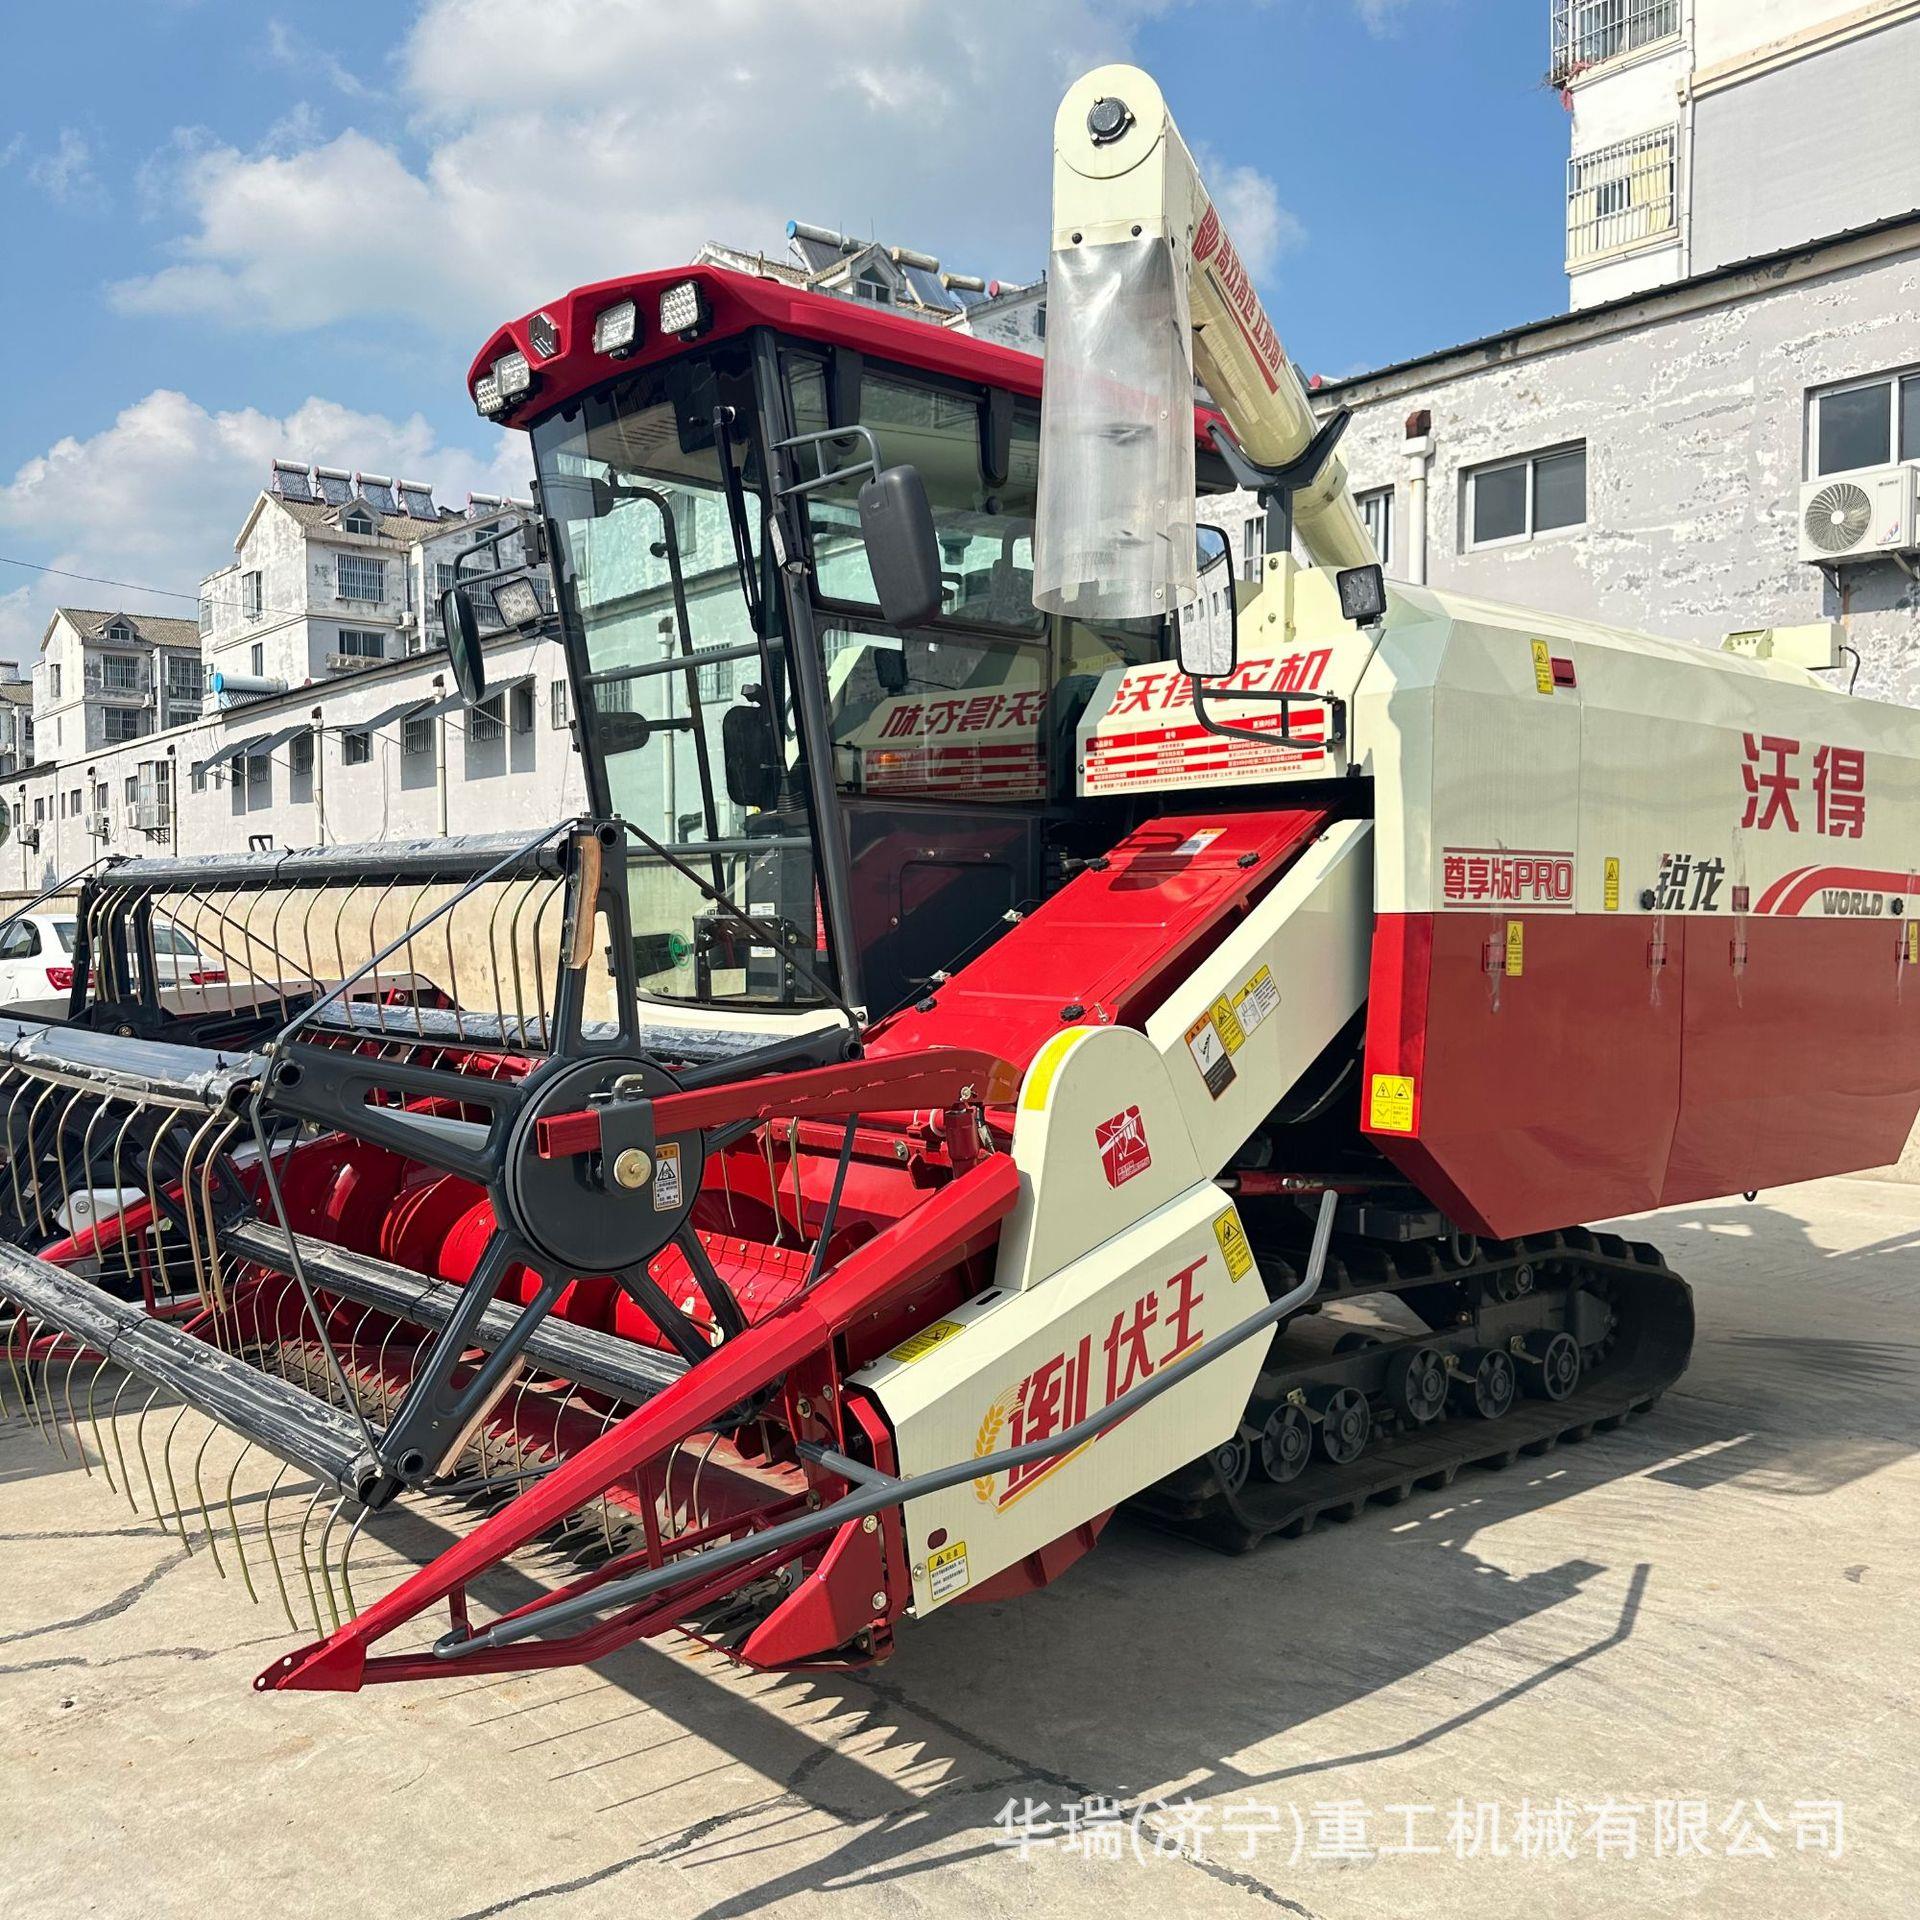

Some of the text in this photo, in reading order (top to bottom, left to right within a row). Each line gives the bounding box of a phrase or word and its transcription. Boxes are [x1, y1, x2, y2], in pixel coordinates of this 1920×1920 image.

[1741, 733, 1865, 839] 沃得
[1443, 856, 1574, 900] 尊享版PRO
[1655, 853, 1725, 911] 锐龙
[1822, 890, 1884, 916] WORLD
